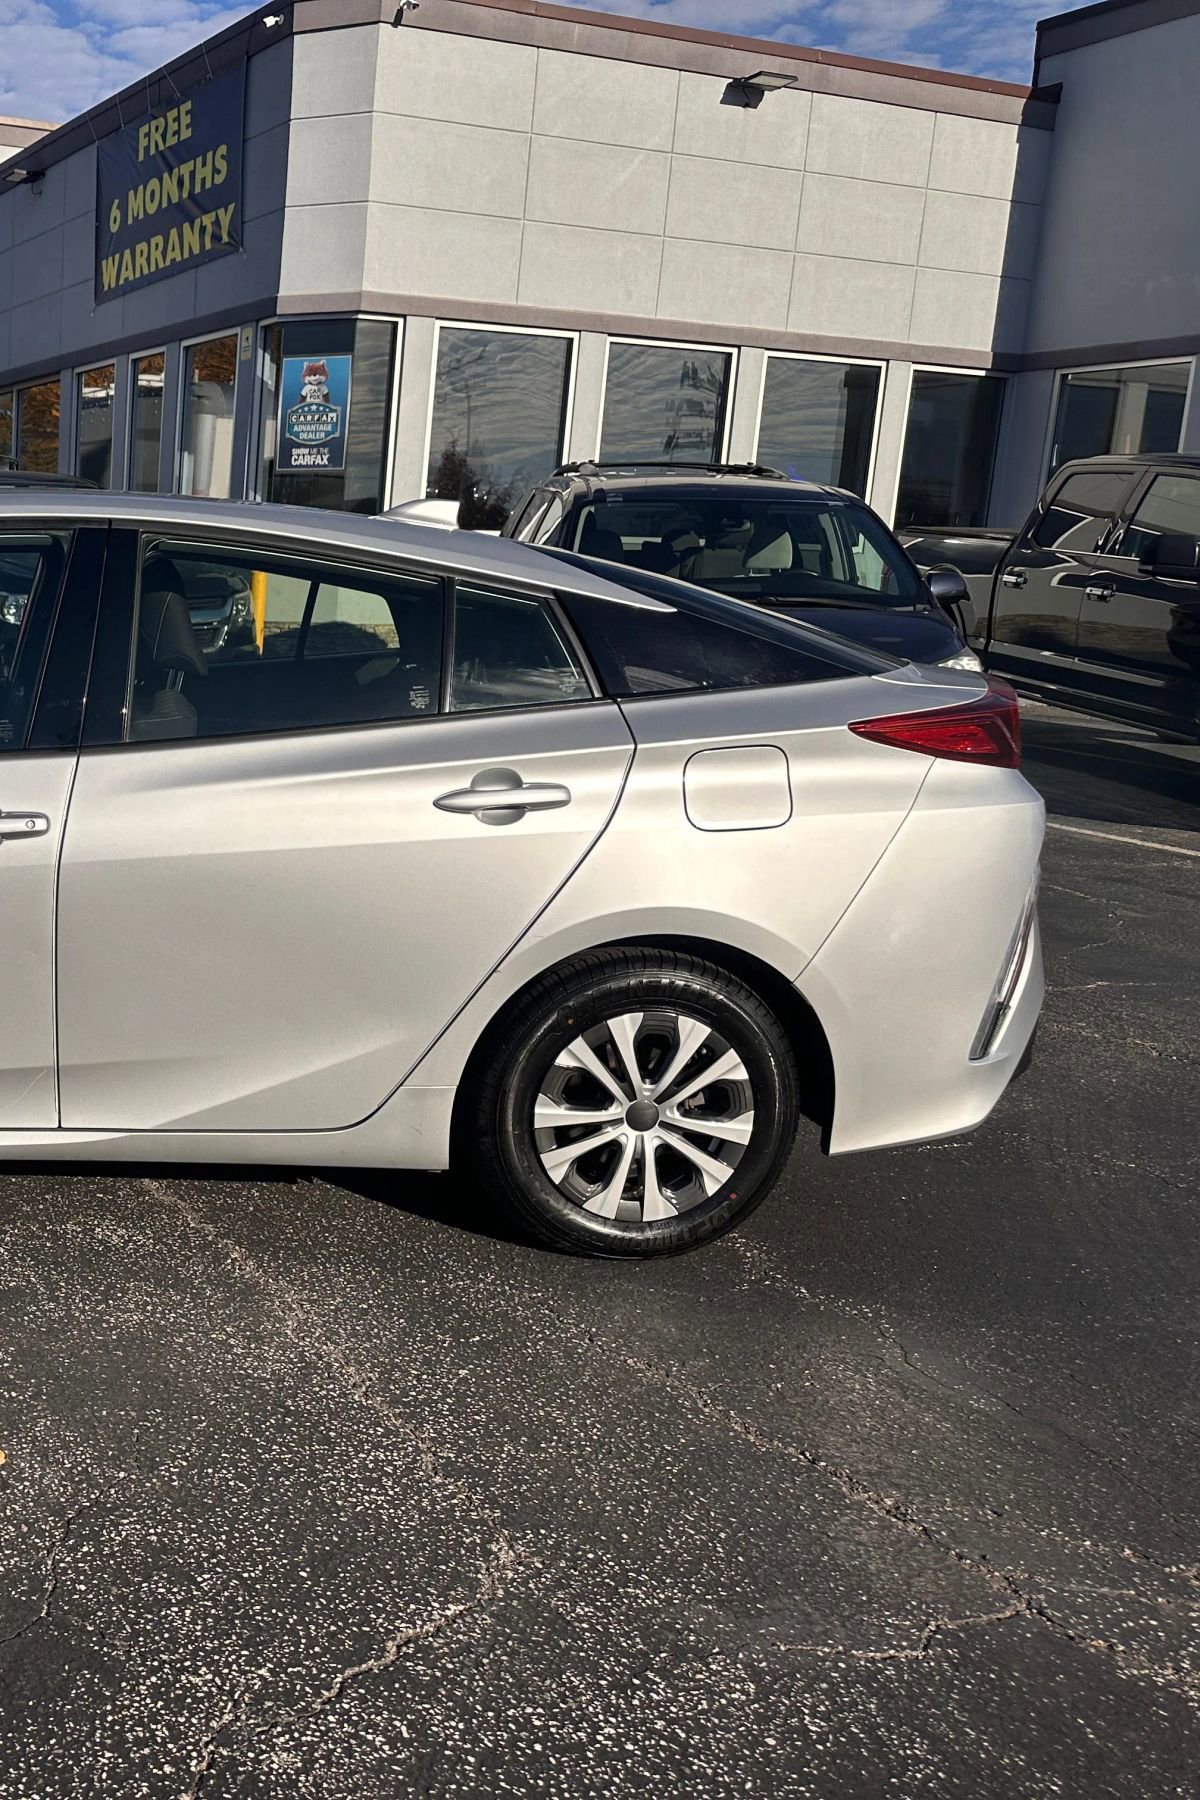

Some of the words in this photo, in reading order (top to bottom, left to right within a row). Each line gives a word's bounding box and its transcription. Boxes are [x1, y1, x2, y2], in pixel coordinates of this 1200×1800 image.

[138, 100, 193, 162] FREE
[109, 198, 122, 234] 6
[127, 144, 229, 226] MONTHS
[101, 201, 236, 292] WARRANTY
[291, 413, 337, 423] CARFAX
[293, 423, 333, 432] ADVANTAGE
[299, 432, 326, 440] DEALER
[291, 447, 310, 455] SHOW
[291, 454, 330, 466] CARFAX
